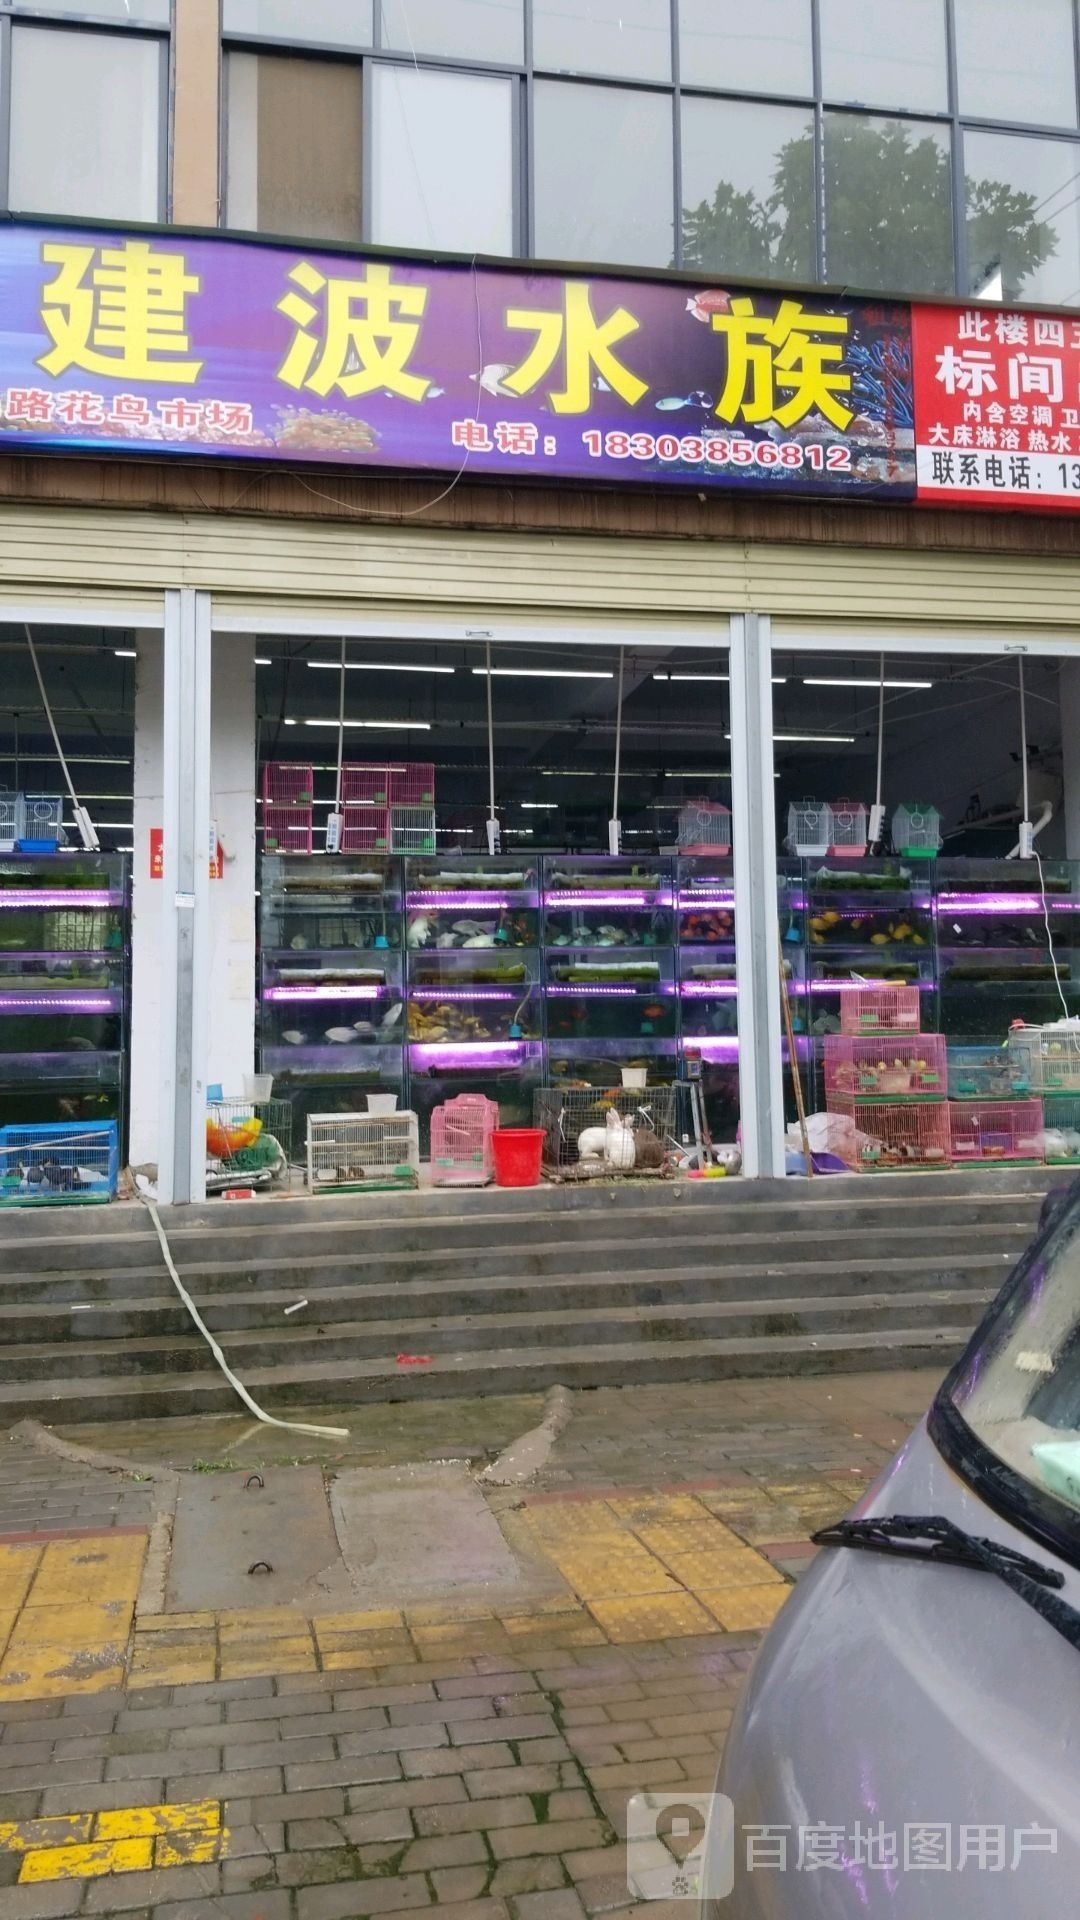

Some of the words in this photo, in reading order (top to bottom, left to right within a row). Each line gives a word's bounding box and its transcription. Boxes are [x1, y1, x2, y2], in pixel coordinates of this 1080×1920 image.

[34, 240, 855, 432] 建波水族
[935, 346, 1080, 403] 标间
[6, 388, 253, 434] 路花鸟市场
[582, 430, 851, 470] 18303856812
[1028, 430, 1080, 453] 热水
